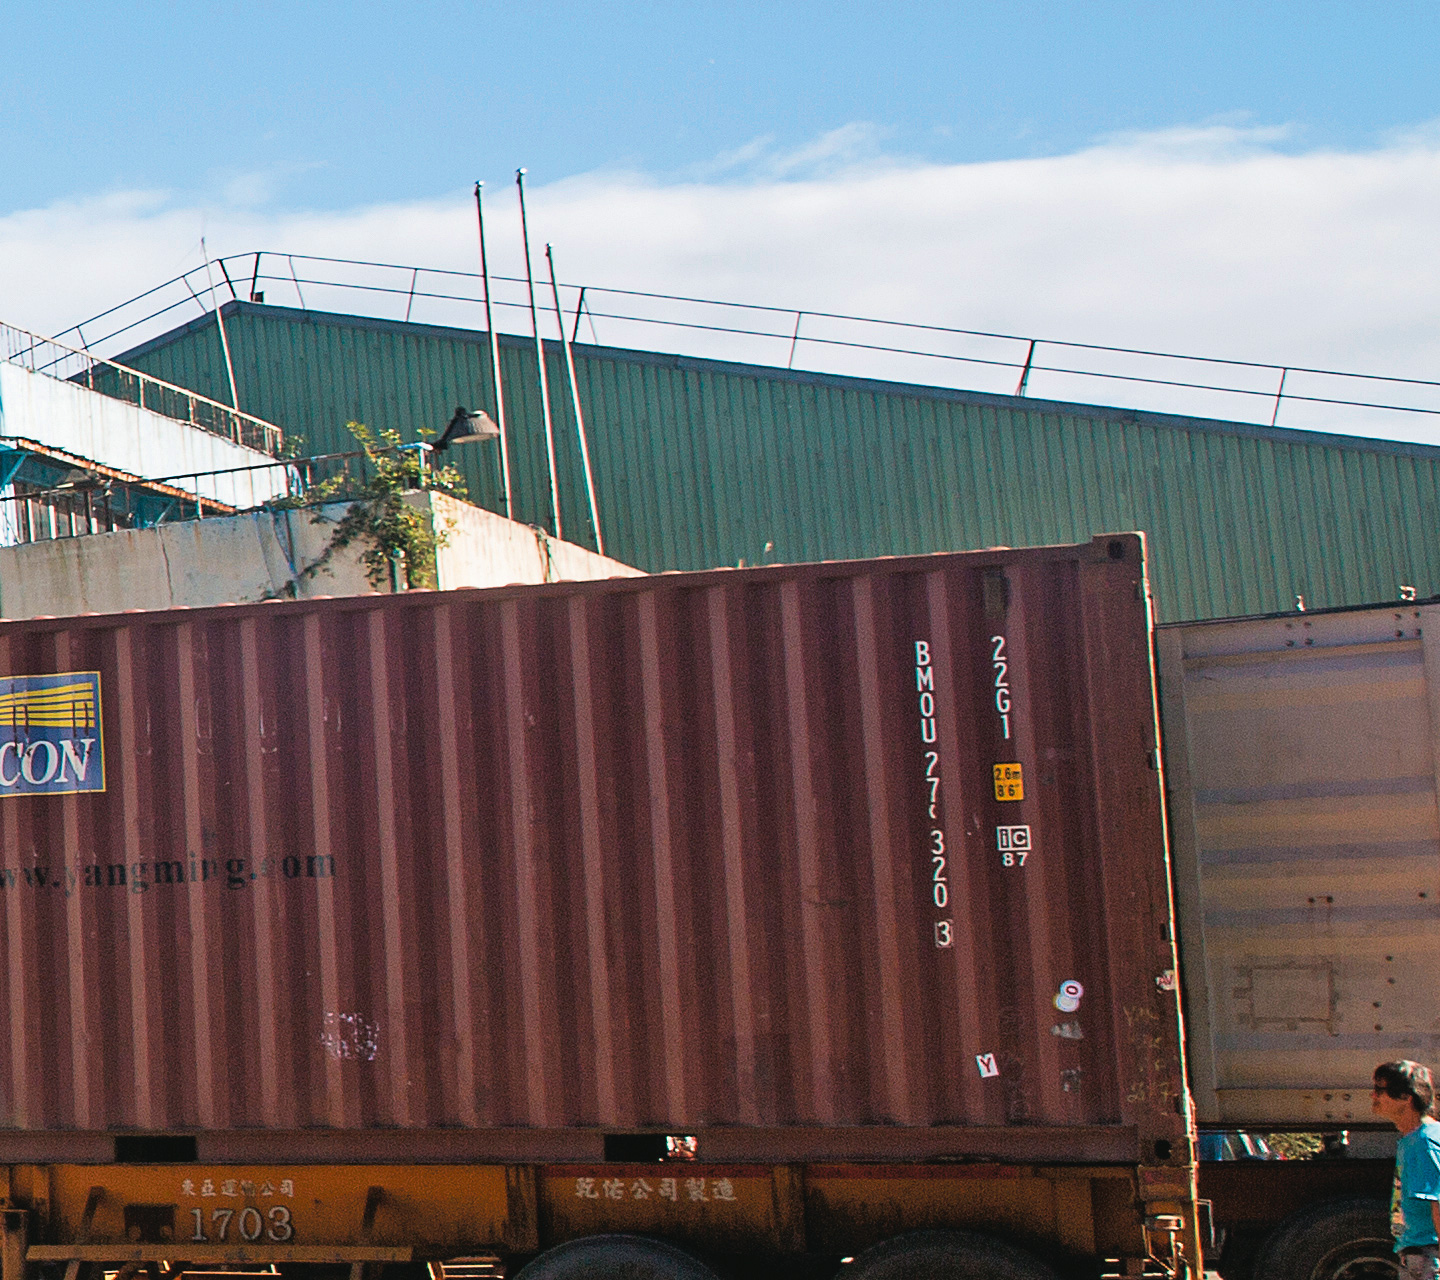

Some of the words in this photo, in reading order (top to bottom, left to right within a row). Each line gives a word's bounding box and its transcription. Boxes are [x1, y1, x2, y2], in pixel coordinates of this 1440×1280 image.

[991, 635, 1011, 739] 22G1
[915, 640, 937, 743] BMOU
[937, 921, 951, 946] 3
[1002, 852, 1028, 867] 87
[980, 1056, 992, 1074] Y
[190, 1206, 292, 1241] 1703
